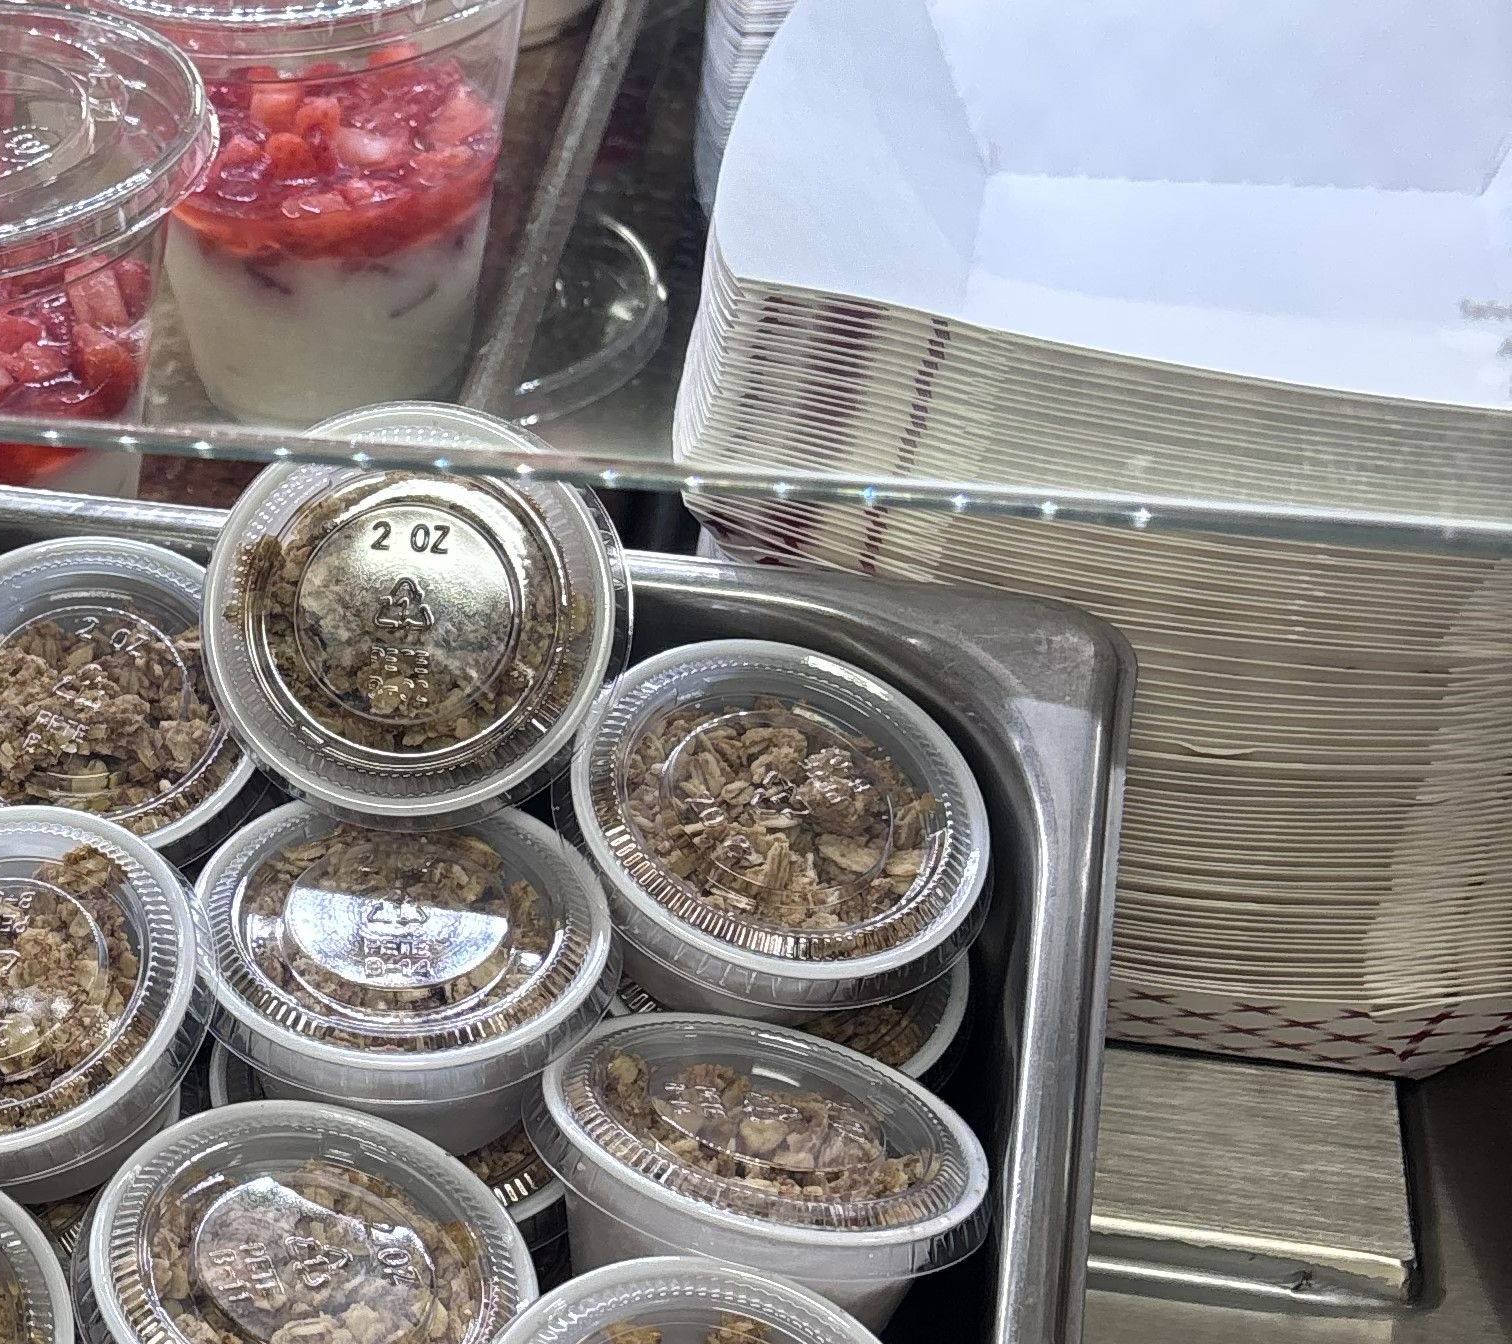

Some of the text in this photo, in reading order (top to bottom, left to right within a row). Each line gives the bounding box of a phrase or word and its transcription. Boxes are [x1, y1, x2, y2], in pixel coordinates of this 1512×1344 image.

[370, 520, 452, 555] 2 OZ
[75, 616, 100, 641] 2
